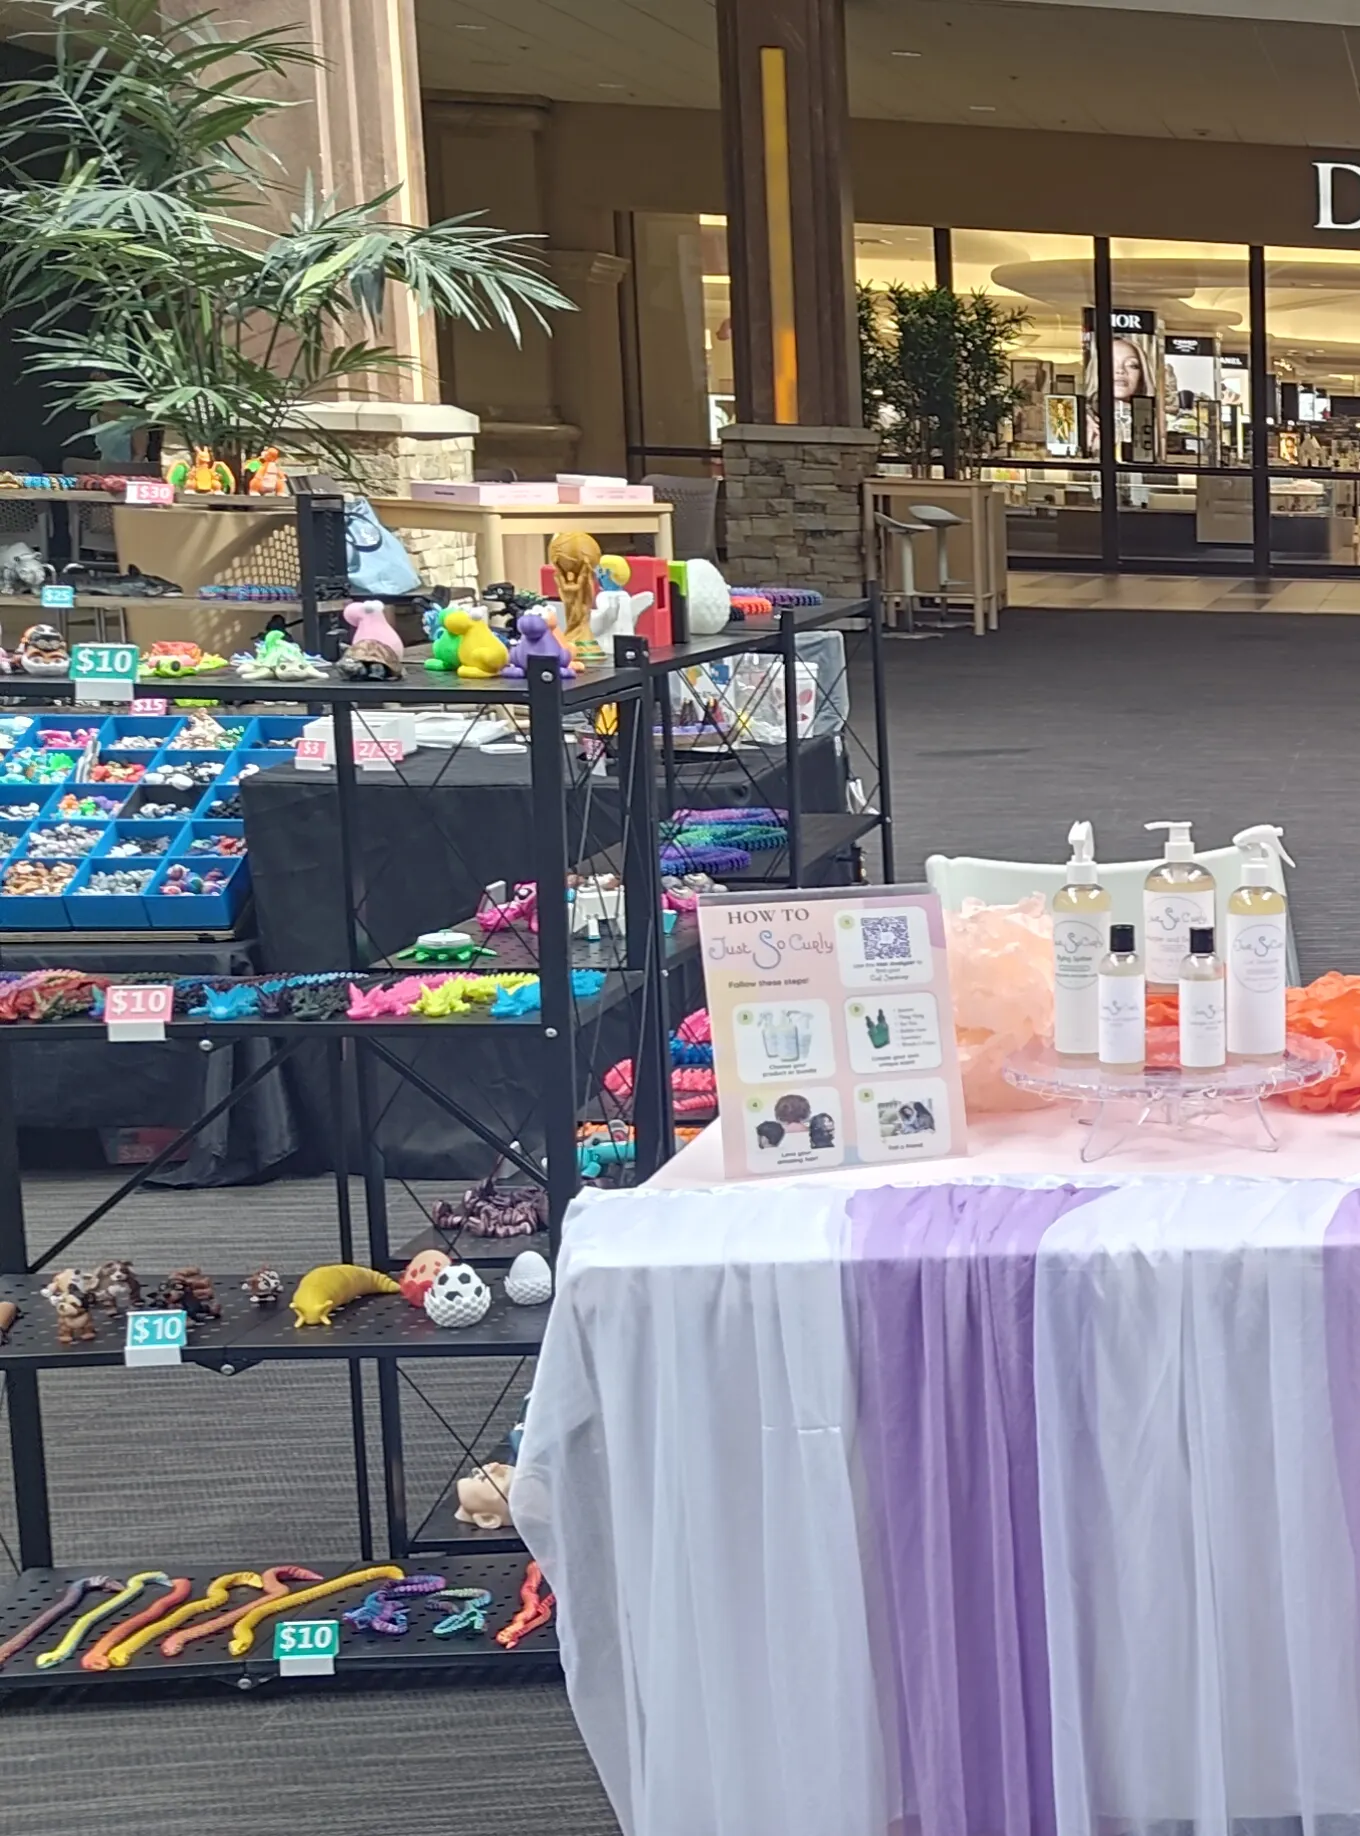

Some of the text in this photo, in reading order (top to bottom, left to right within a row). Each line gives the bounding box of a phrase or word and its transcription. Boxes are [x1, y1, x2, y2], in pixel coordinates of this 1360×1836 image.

[1110, 314, 1141, 329] IOR
[140, 485, 171, 499] $30
[44, 589, 71, 601] $25
[76, 648, 132, 674] $10
[134, 699, 163, 712] $15
[303, 740, 319, 755] $3
[728, 907, 810, 925] HOW TO
[709, 929, 834, 970] Just So Curly
[728, 980, 756, 989] Follow
[758, 979, 781, 988] these
[111, 989, 166, 1016] $10
[133, 1316, 182, 1344] $10
[279, 1625, 333, 1652] $10
